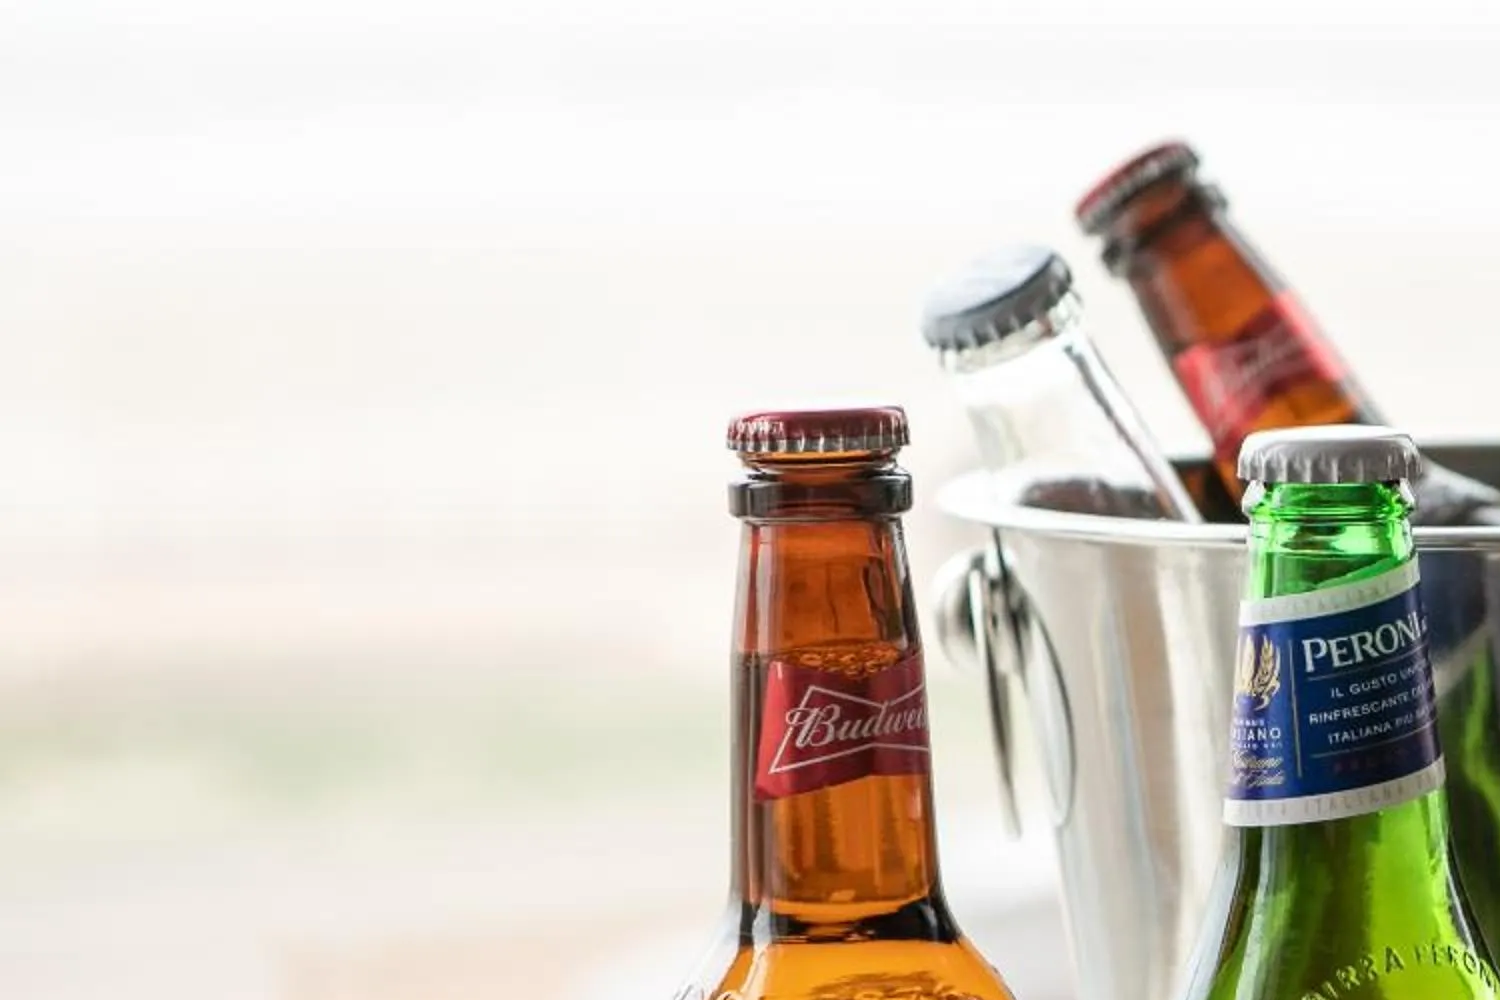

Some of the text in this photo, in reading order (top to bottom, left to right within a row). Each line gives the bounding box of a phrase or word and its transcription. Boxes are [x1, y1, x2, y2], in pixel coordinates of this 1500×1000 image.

[1330, 687, 1344, 699] IL
[1348, 673, 1398, 696] GUSTO
[1327, 720, 1392, 745] ITALIANA
